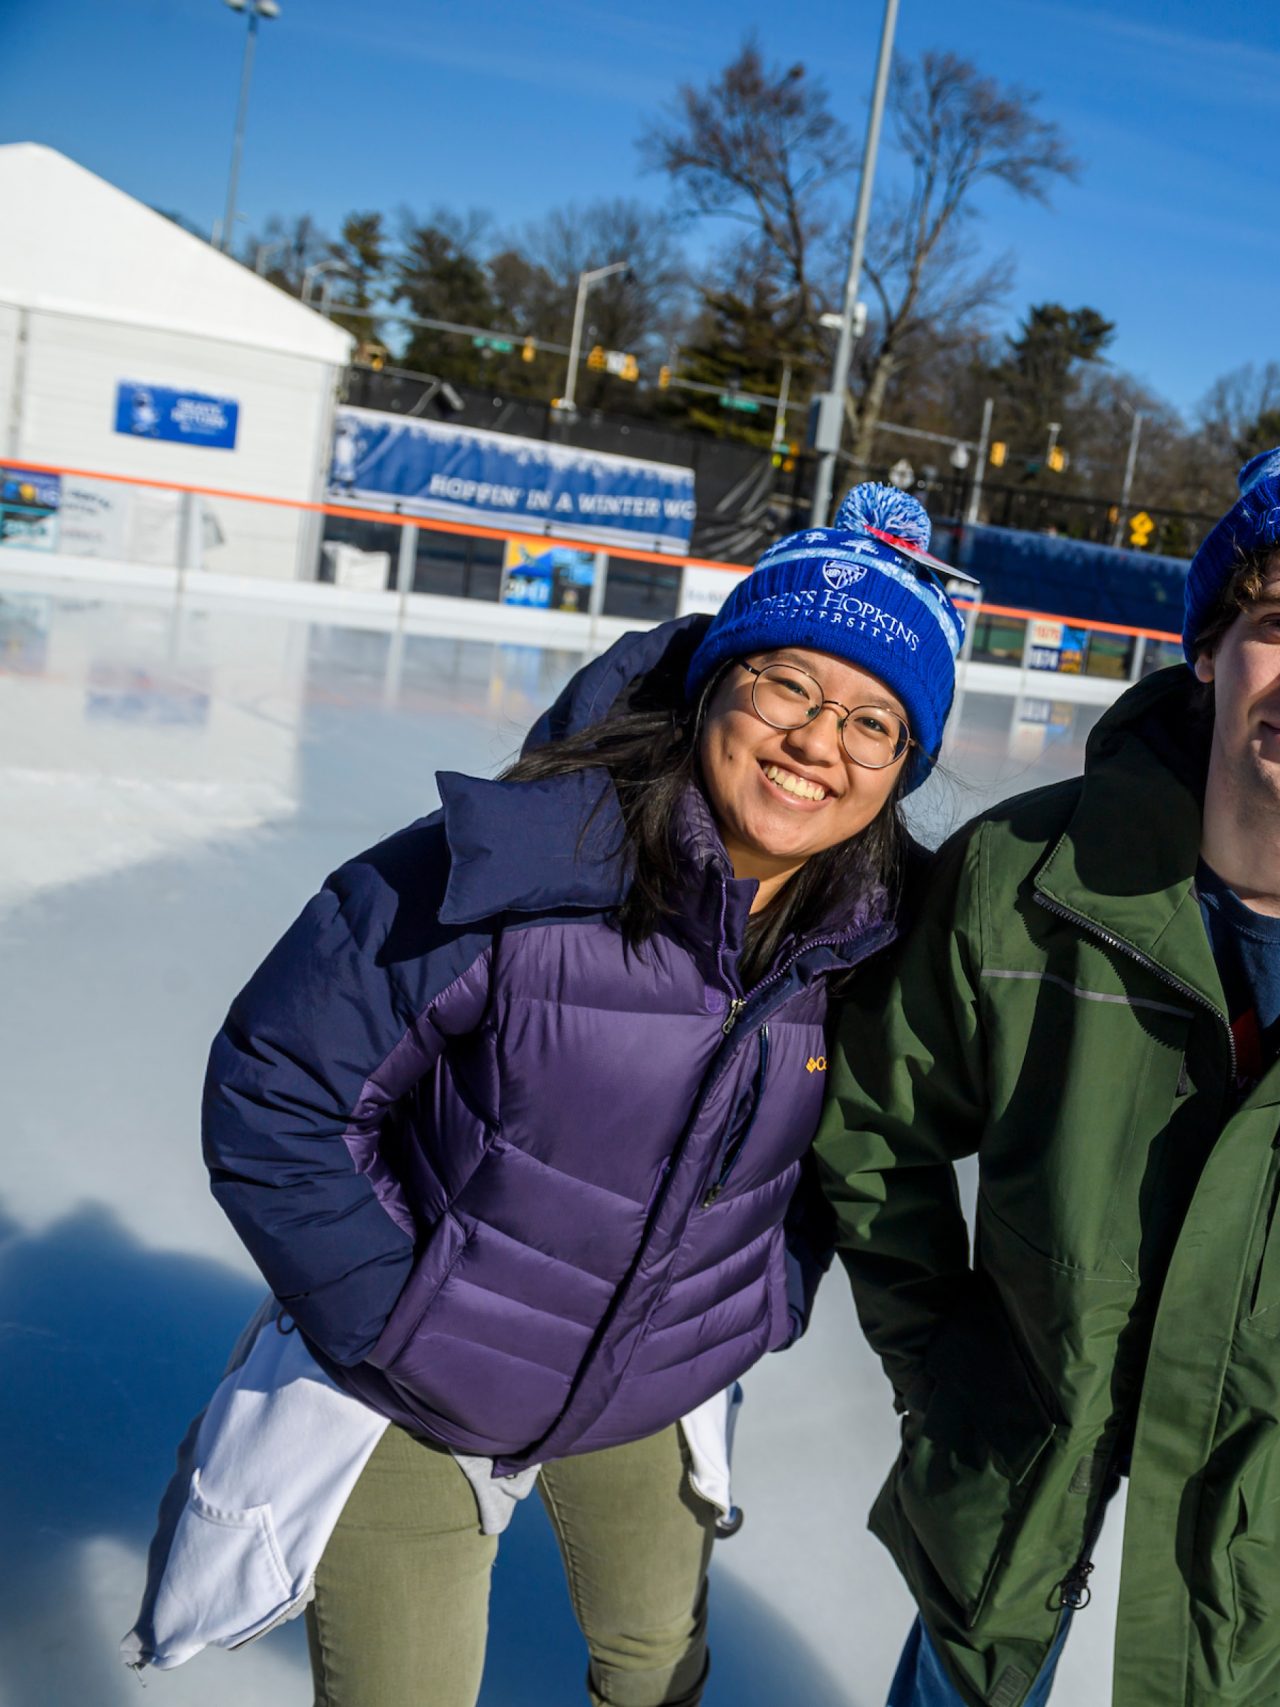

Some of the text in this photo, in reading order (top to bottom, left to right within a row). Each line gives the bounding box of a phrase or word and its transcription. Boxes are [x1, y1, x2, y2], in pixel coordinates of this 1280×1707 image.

[526, 489, 553, 511] IN
[555, 491, 574, 513] A
[578, 493, 661, 518] WINTER
[764, 608, 894, 644] IVERSITY
[823, 588, 920, 652] HOPKINS
